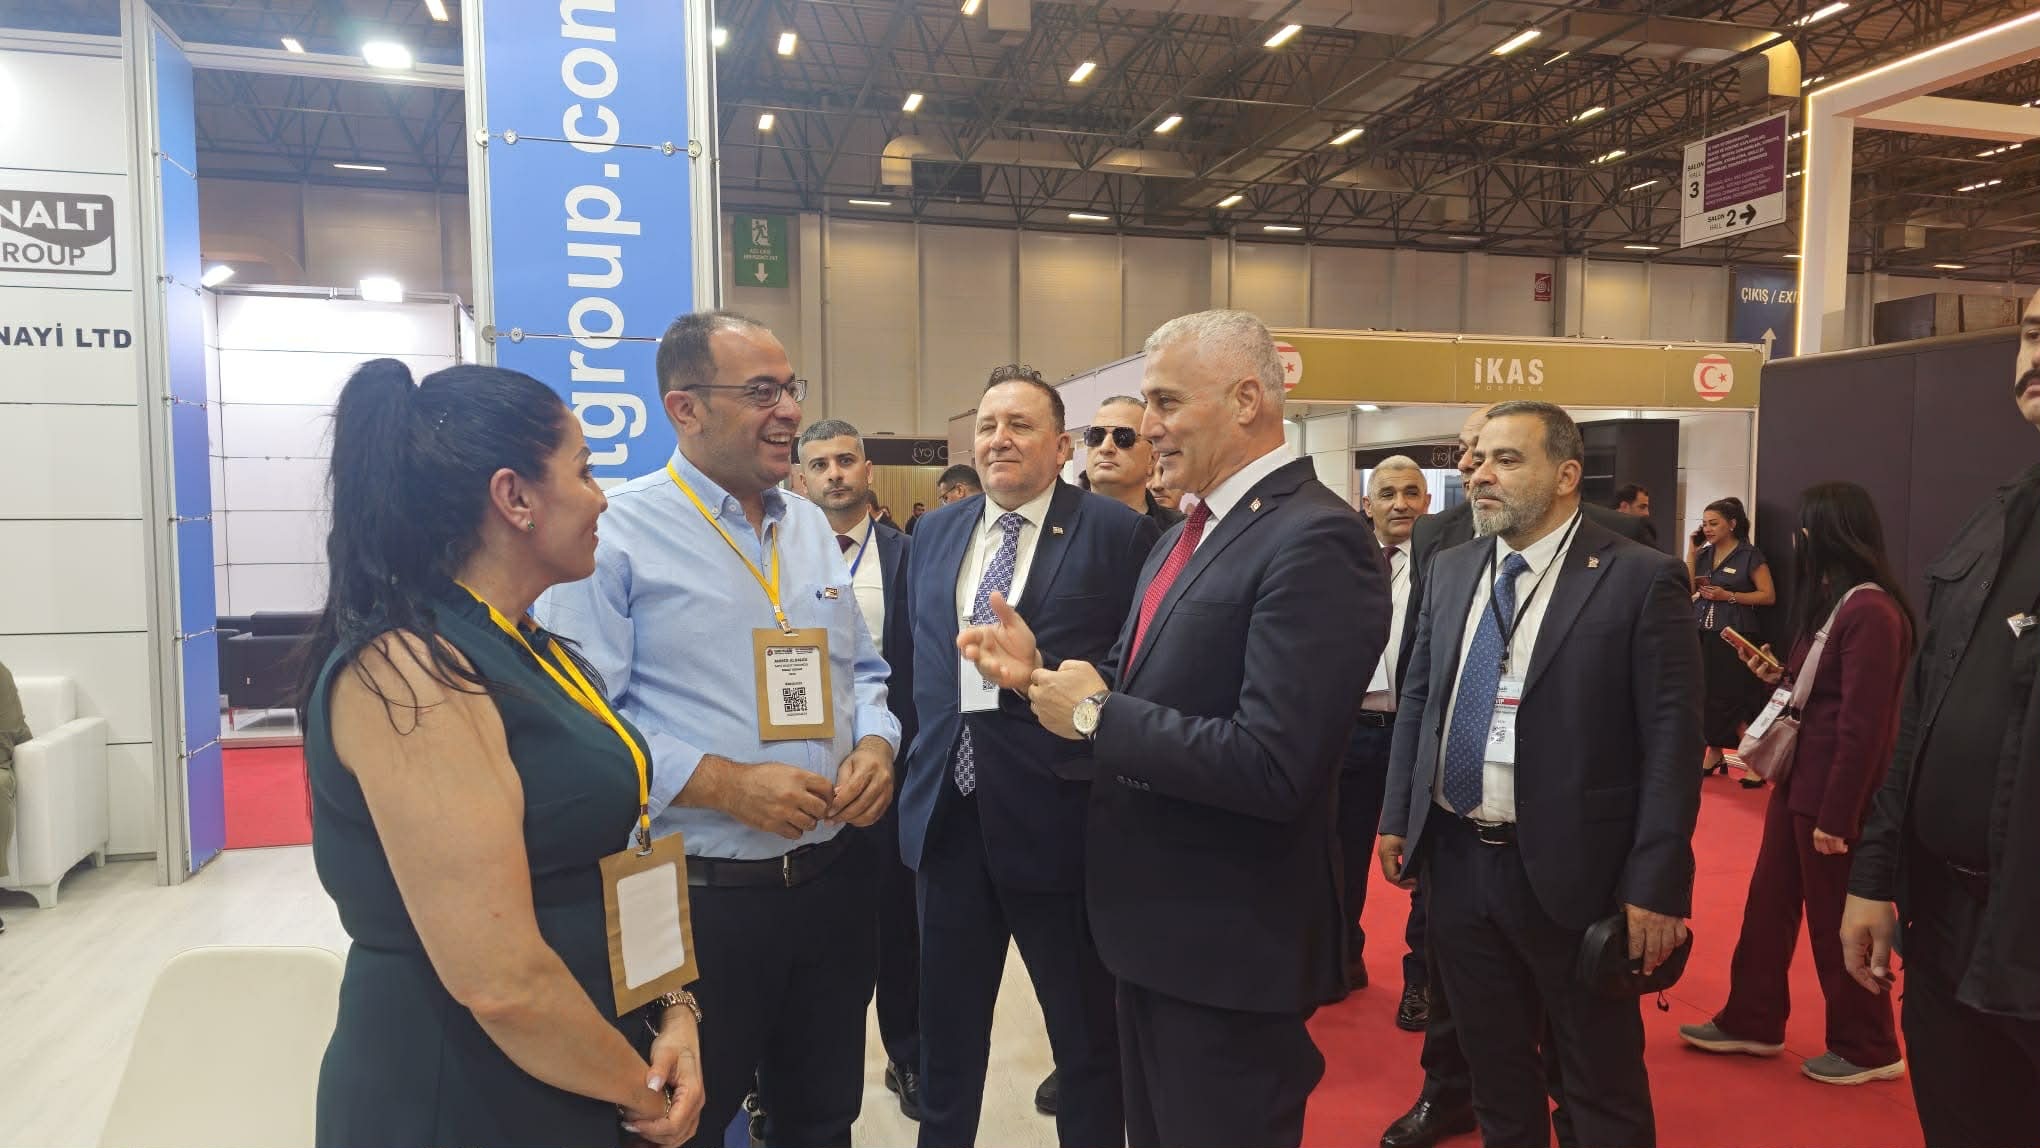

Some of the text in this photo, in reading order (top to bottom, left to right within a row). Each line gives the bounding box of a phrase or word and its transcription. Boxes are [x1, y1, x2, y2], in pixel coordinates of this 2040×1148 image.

[1687, 161, 1705, 171] SALON
[1689, 181, 1700, 199] 3
[1707, 214, 1725, 223] SALON
[1726, 209, 1737, 228] 2
[1741, 287, 1769, 304] ÇIKIŞ
[1770, 289, 1777, 304] /
[75, 328, 132, 348] LTD
